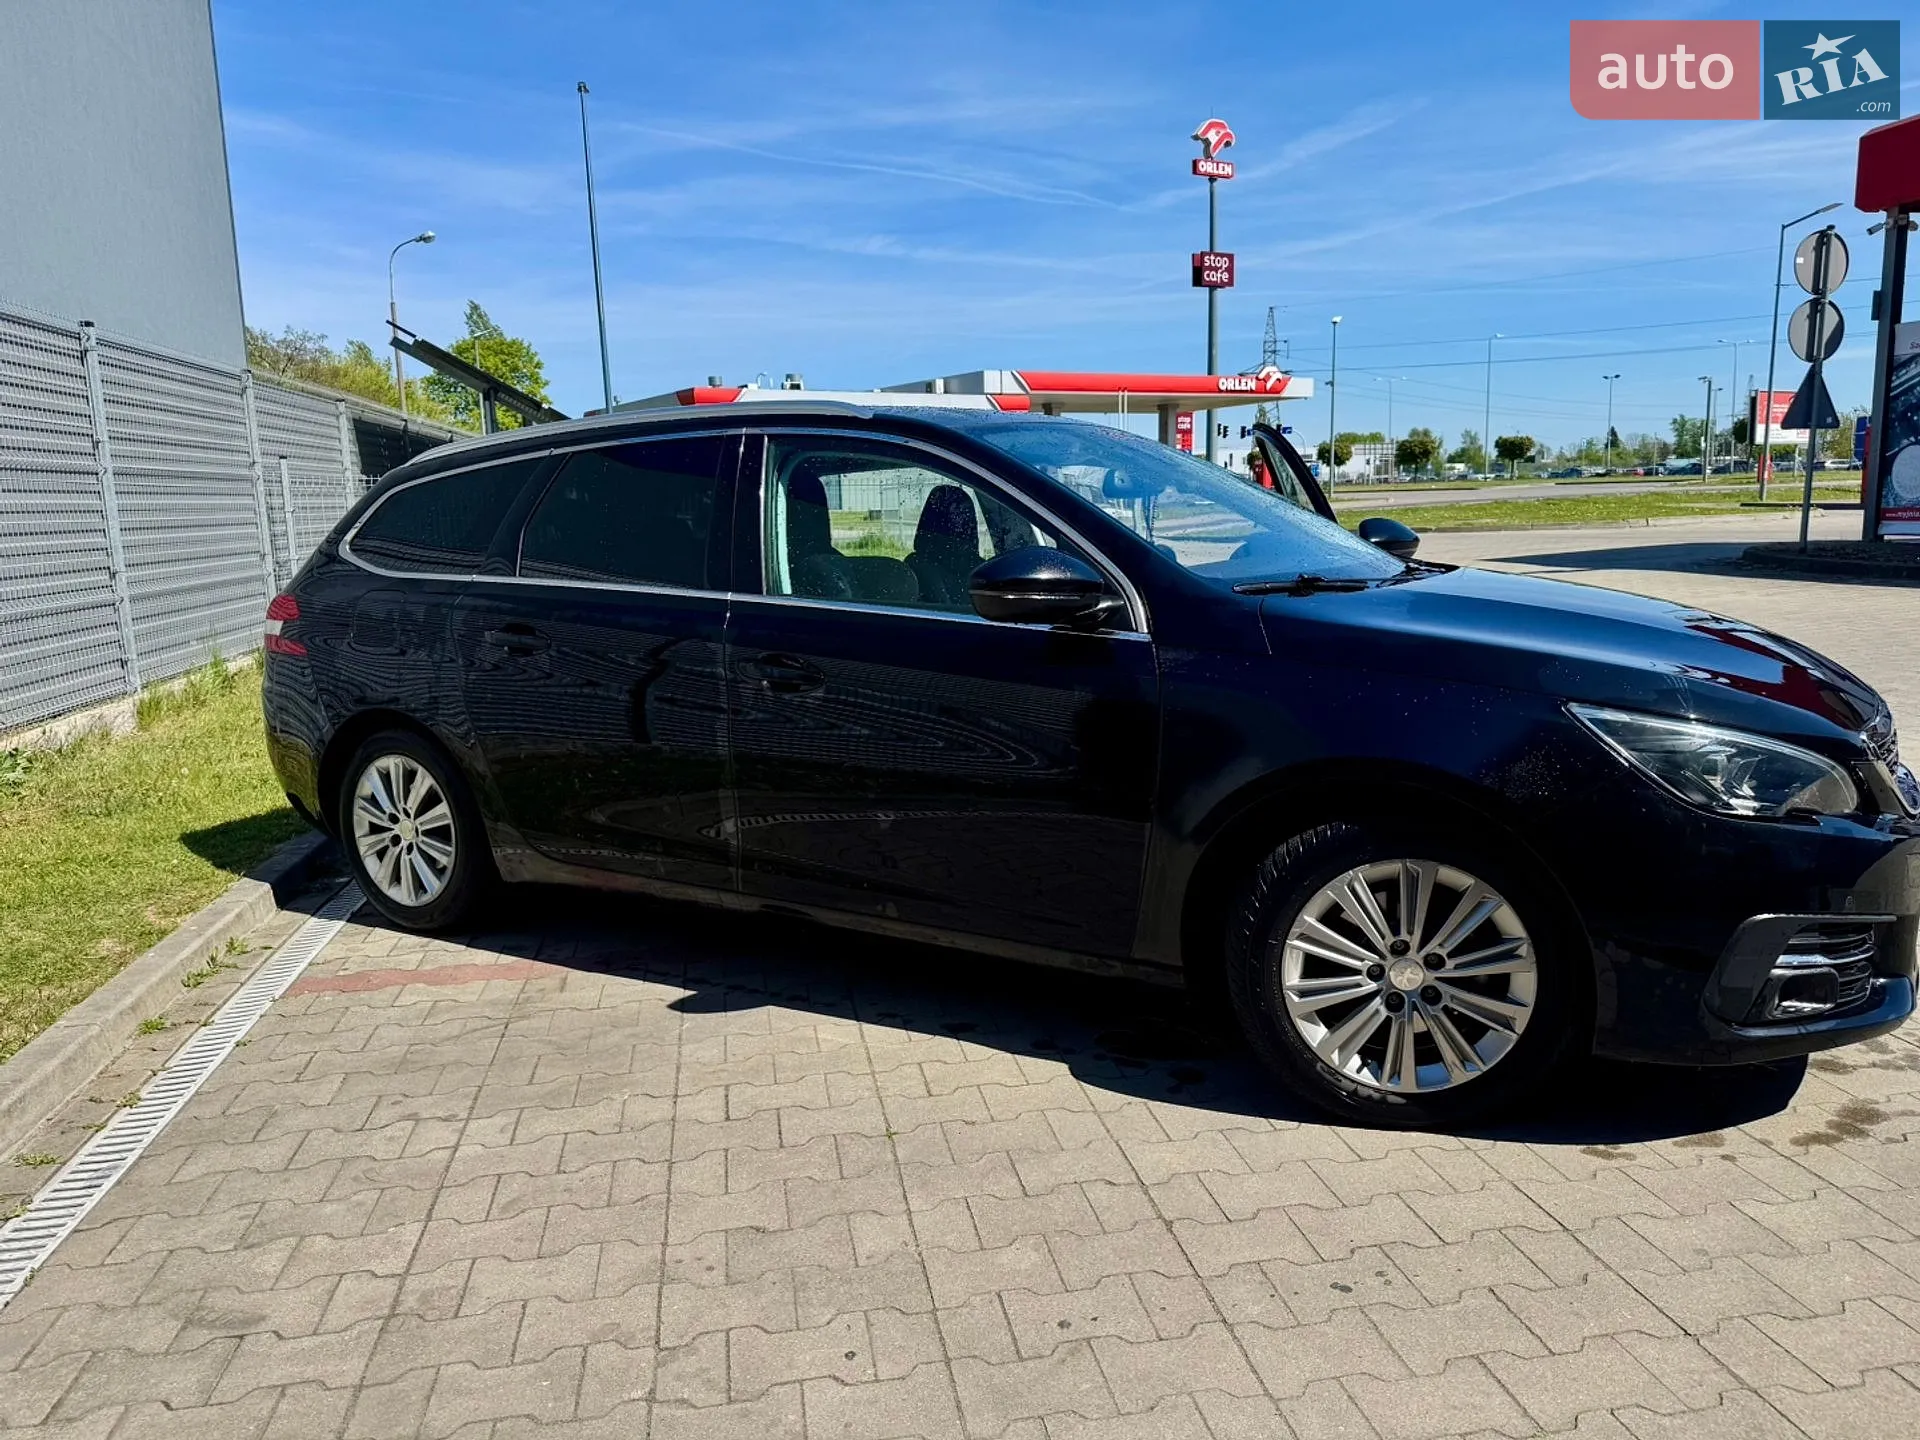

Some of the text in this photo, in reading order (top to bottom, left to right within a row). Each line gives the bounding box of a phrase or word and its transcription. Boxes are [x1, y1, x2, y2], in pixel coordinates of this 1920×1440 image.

[1198, 160, 1232, 176] ORLEN
[1203, 254, 1230, 270] stop
[1203, 267, 1230, 284] cafe
[1218, 377, 1256, 391] ORLEN
